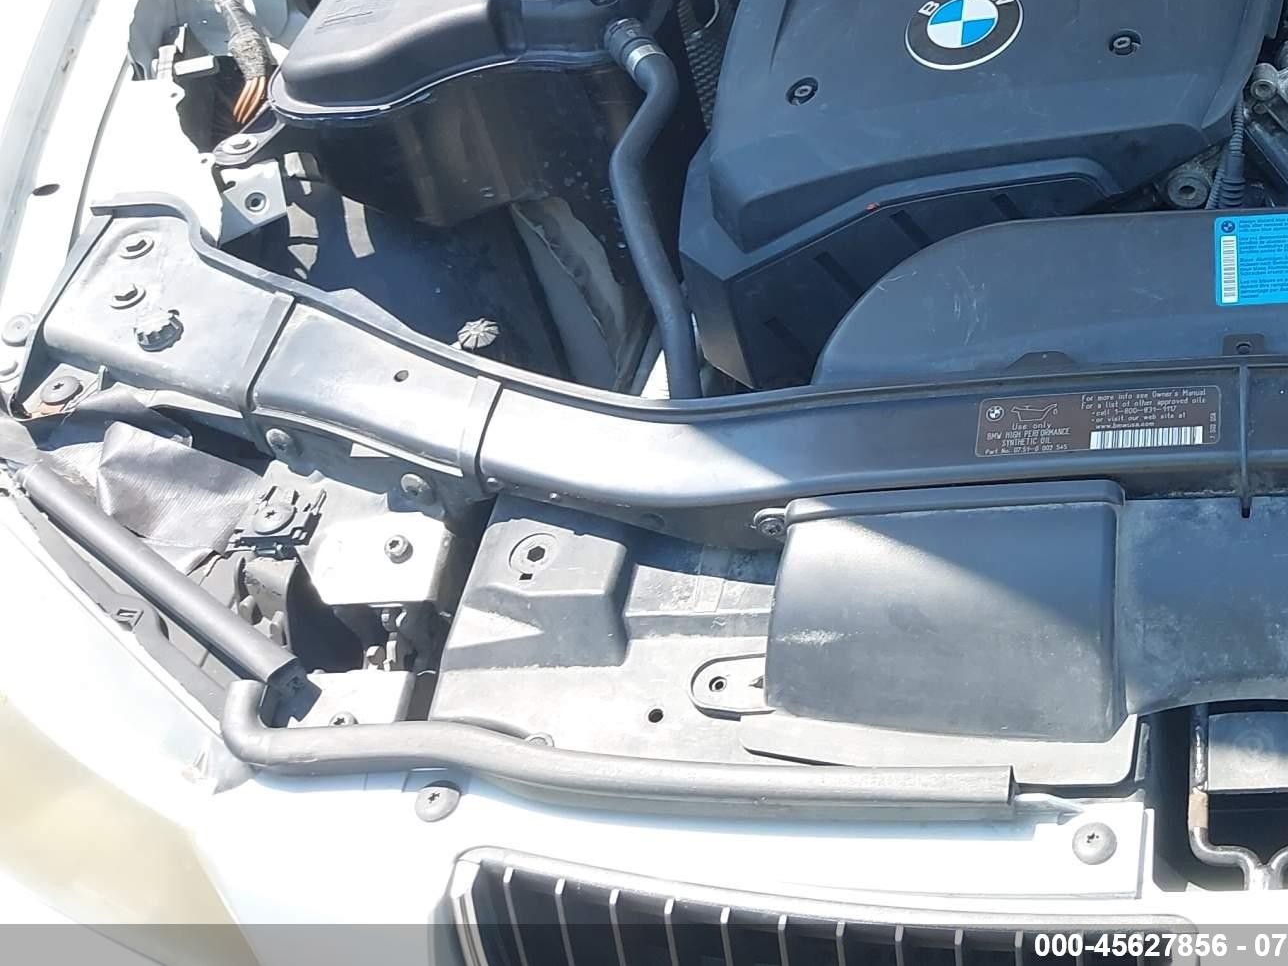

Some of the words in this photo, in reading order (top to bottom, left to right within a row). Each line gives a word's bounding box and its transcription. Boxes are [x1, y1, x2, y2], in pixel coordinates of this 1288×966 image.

[1081, 394, 1094, 402] For
[1118, 392, 1133, 400] info
[1152, 389, 1179, 398] Owner's
[1105, 401, 1119, 409] list
[1157, 398, 1188, 406] approved
[1012, 422, 1027, 431] Use
[1033, 421, 1052, 430] only
